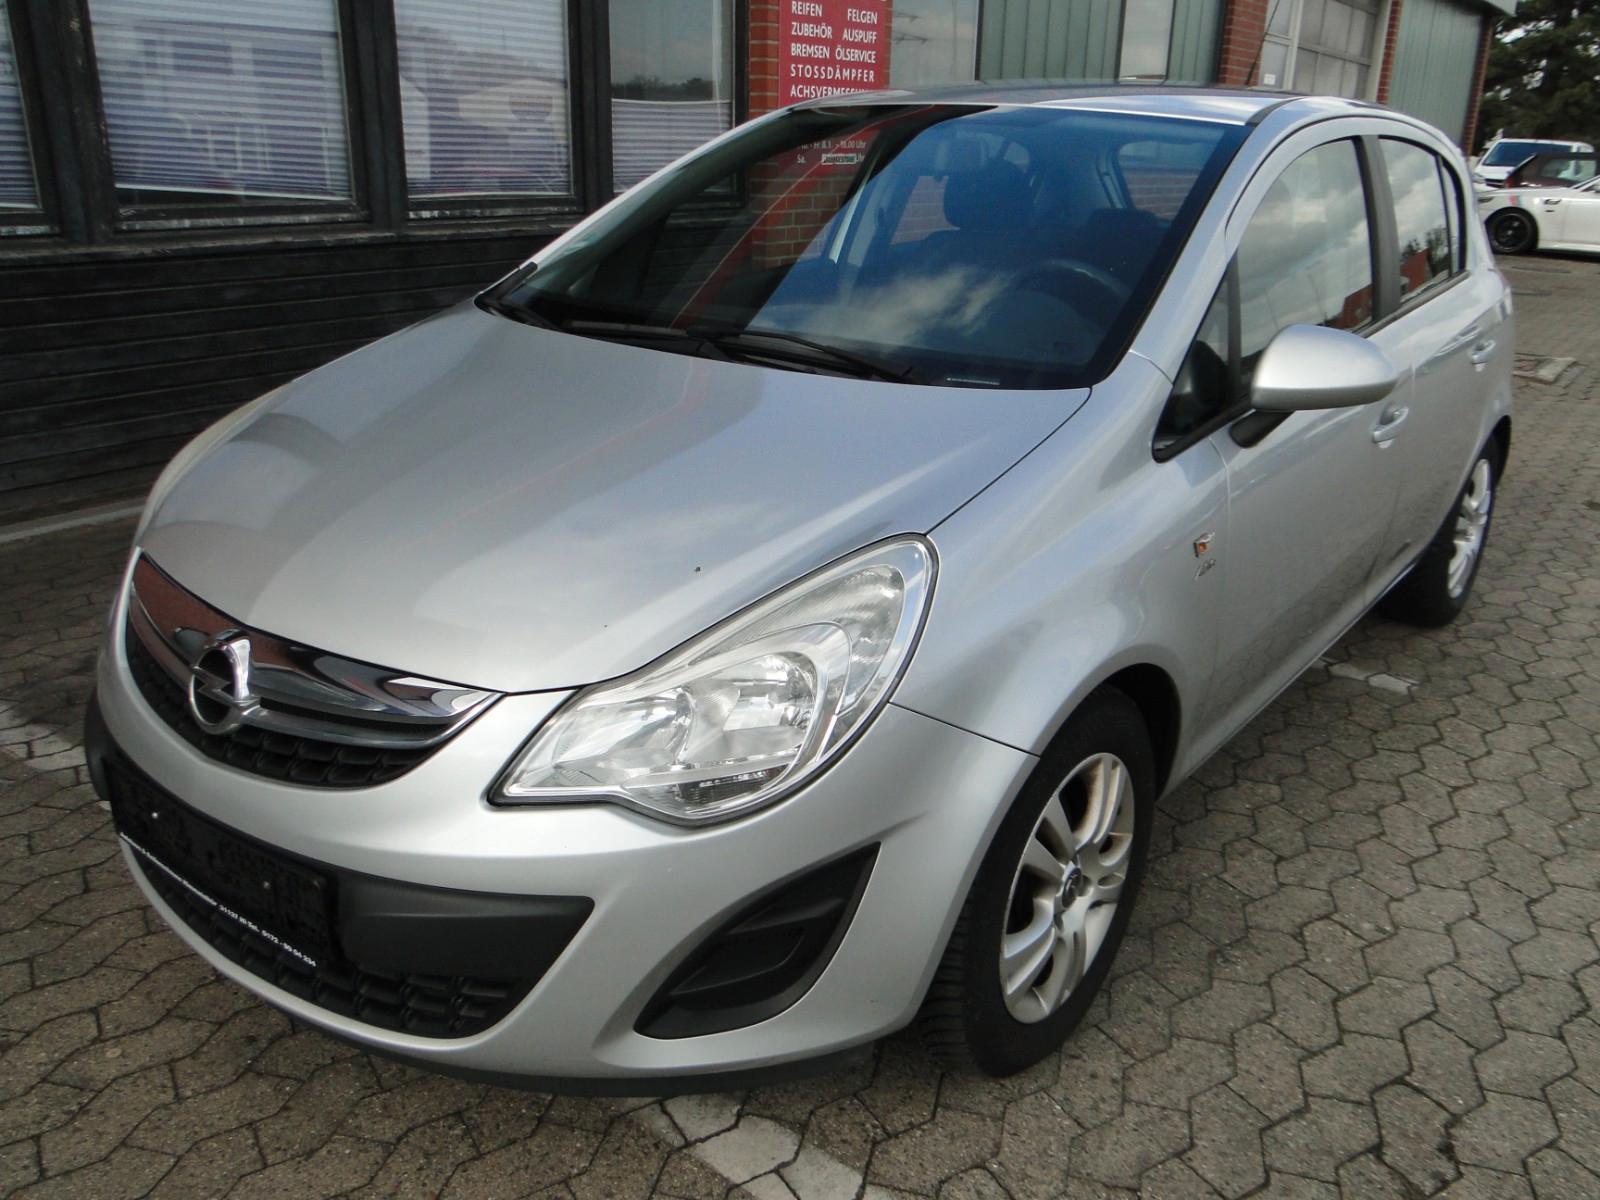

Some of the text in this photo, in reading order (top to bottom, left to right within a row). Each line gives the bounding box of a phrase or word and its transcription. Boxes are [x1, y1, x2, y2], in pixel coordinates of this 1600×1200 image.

[791, 1, 878, 24] REIFEN FELGEN
[791, 21, 877, 44] ZUBEHÖR AUSPUFF
[791, 43, 877, 63] BREMSEN ÖLSERVICE
[790, 64, 875, 82] STOSSDÄMPFER
[790, 84, 868, 98] ACHSVERME
